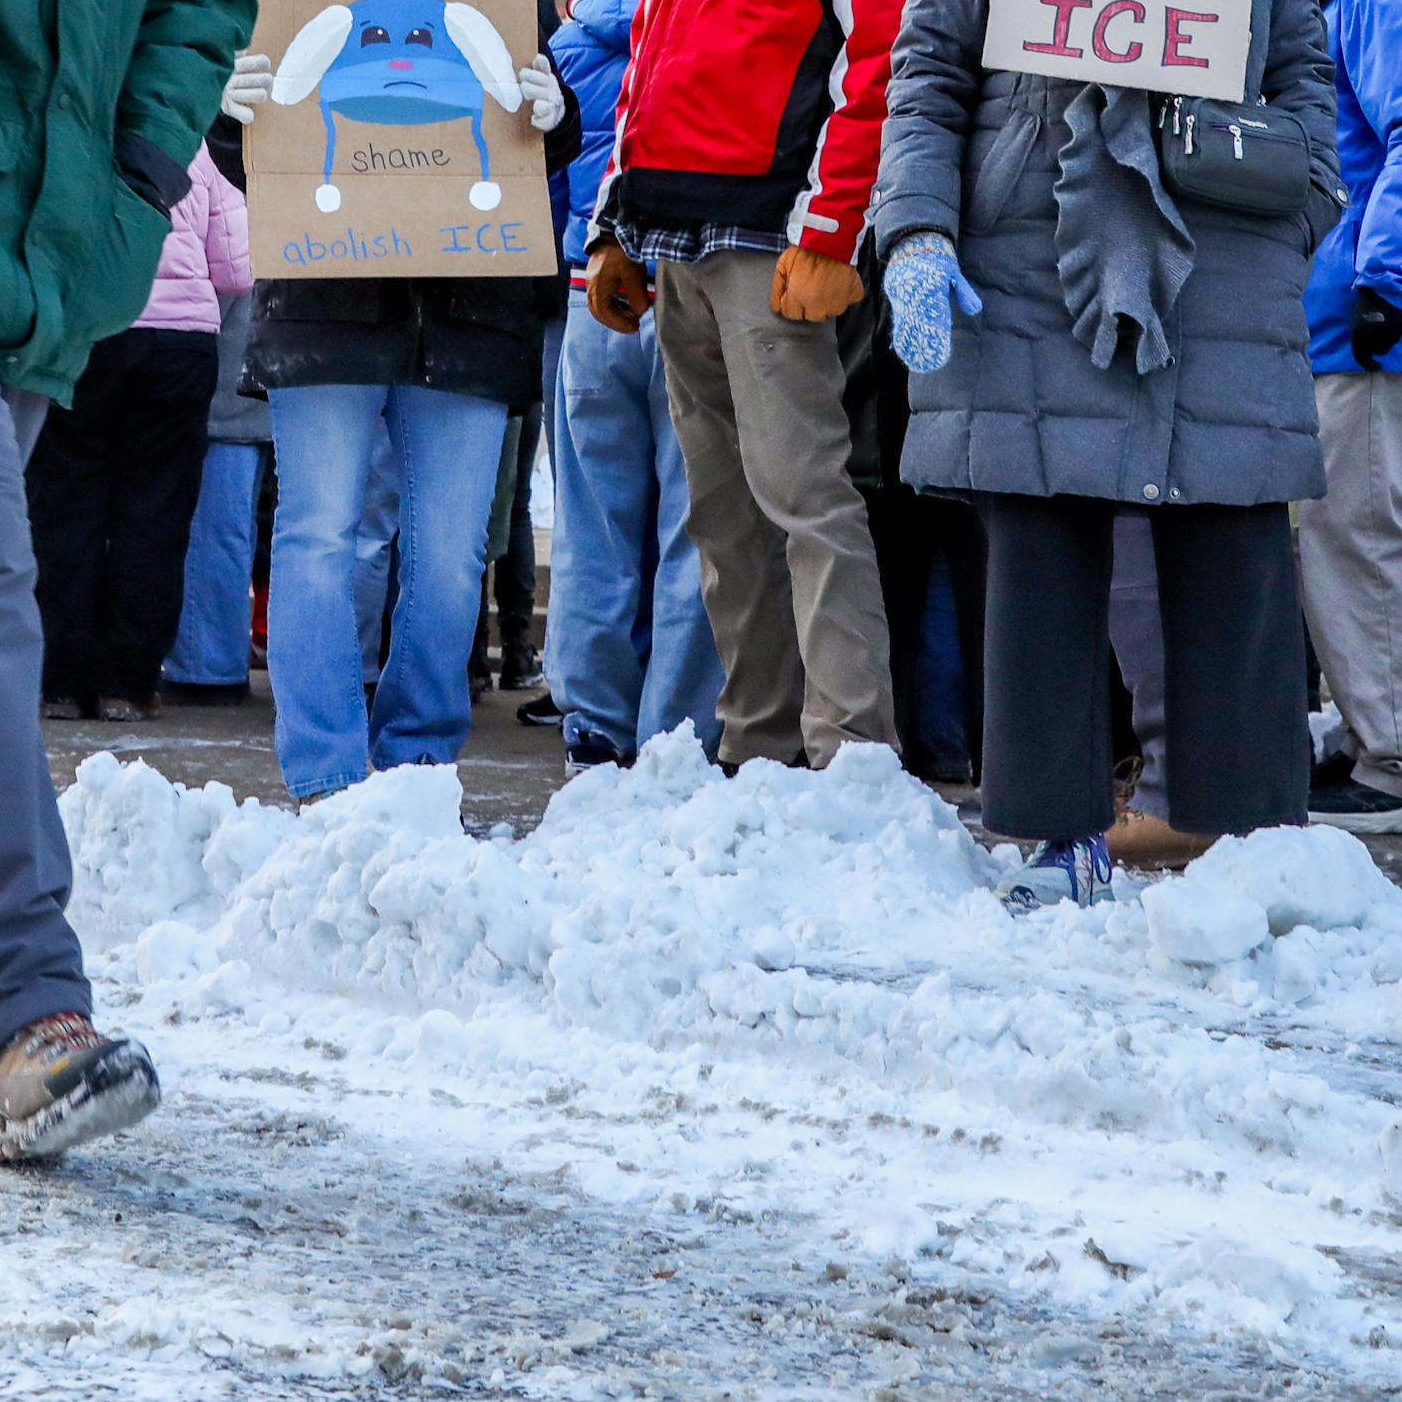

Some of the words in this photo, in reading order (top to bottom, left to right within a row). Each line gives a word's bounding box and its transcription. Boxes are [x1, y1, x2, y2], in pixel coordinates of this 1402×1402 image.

[351, 142, 451, 172] shame
[282, 227, 413, 265] abolish
[439, 222, 529, 254] ICE
